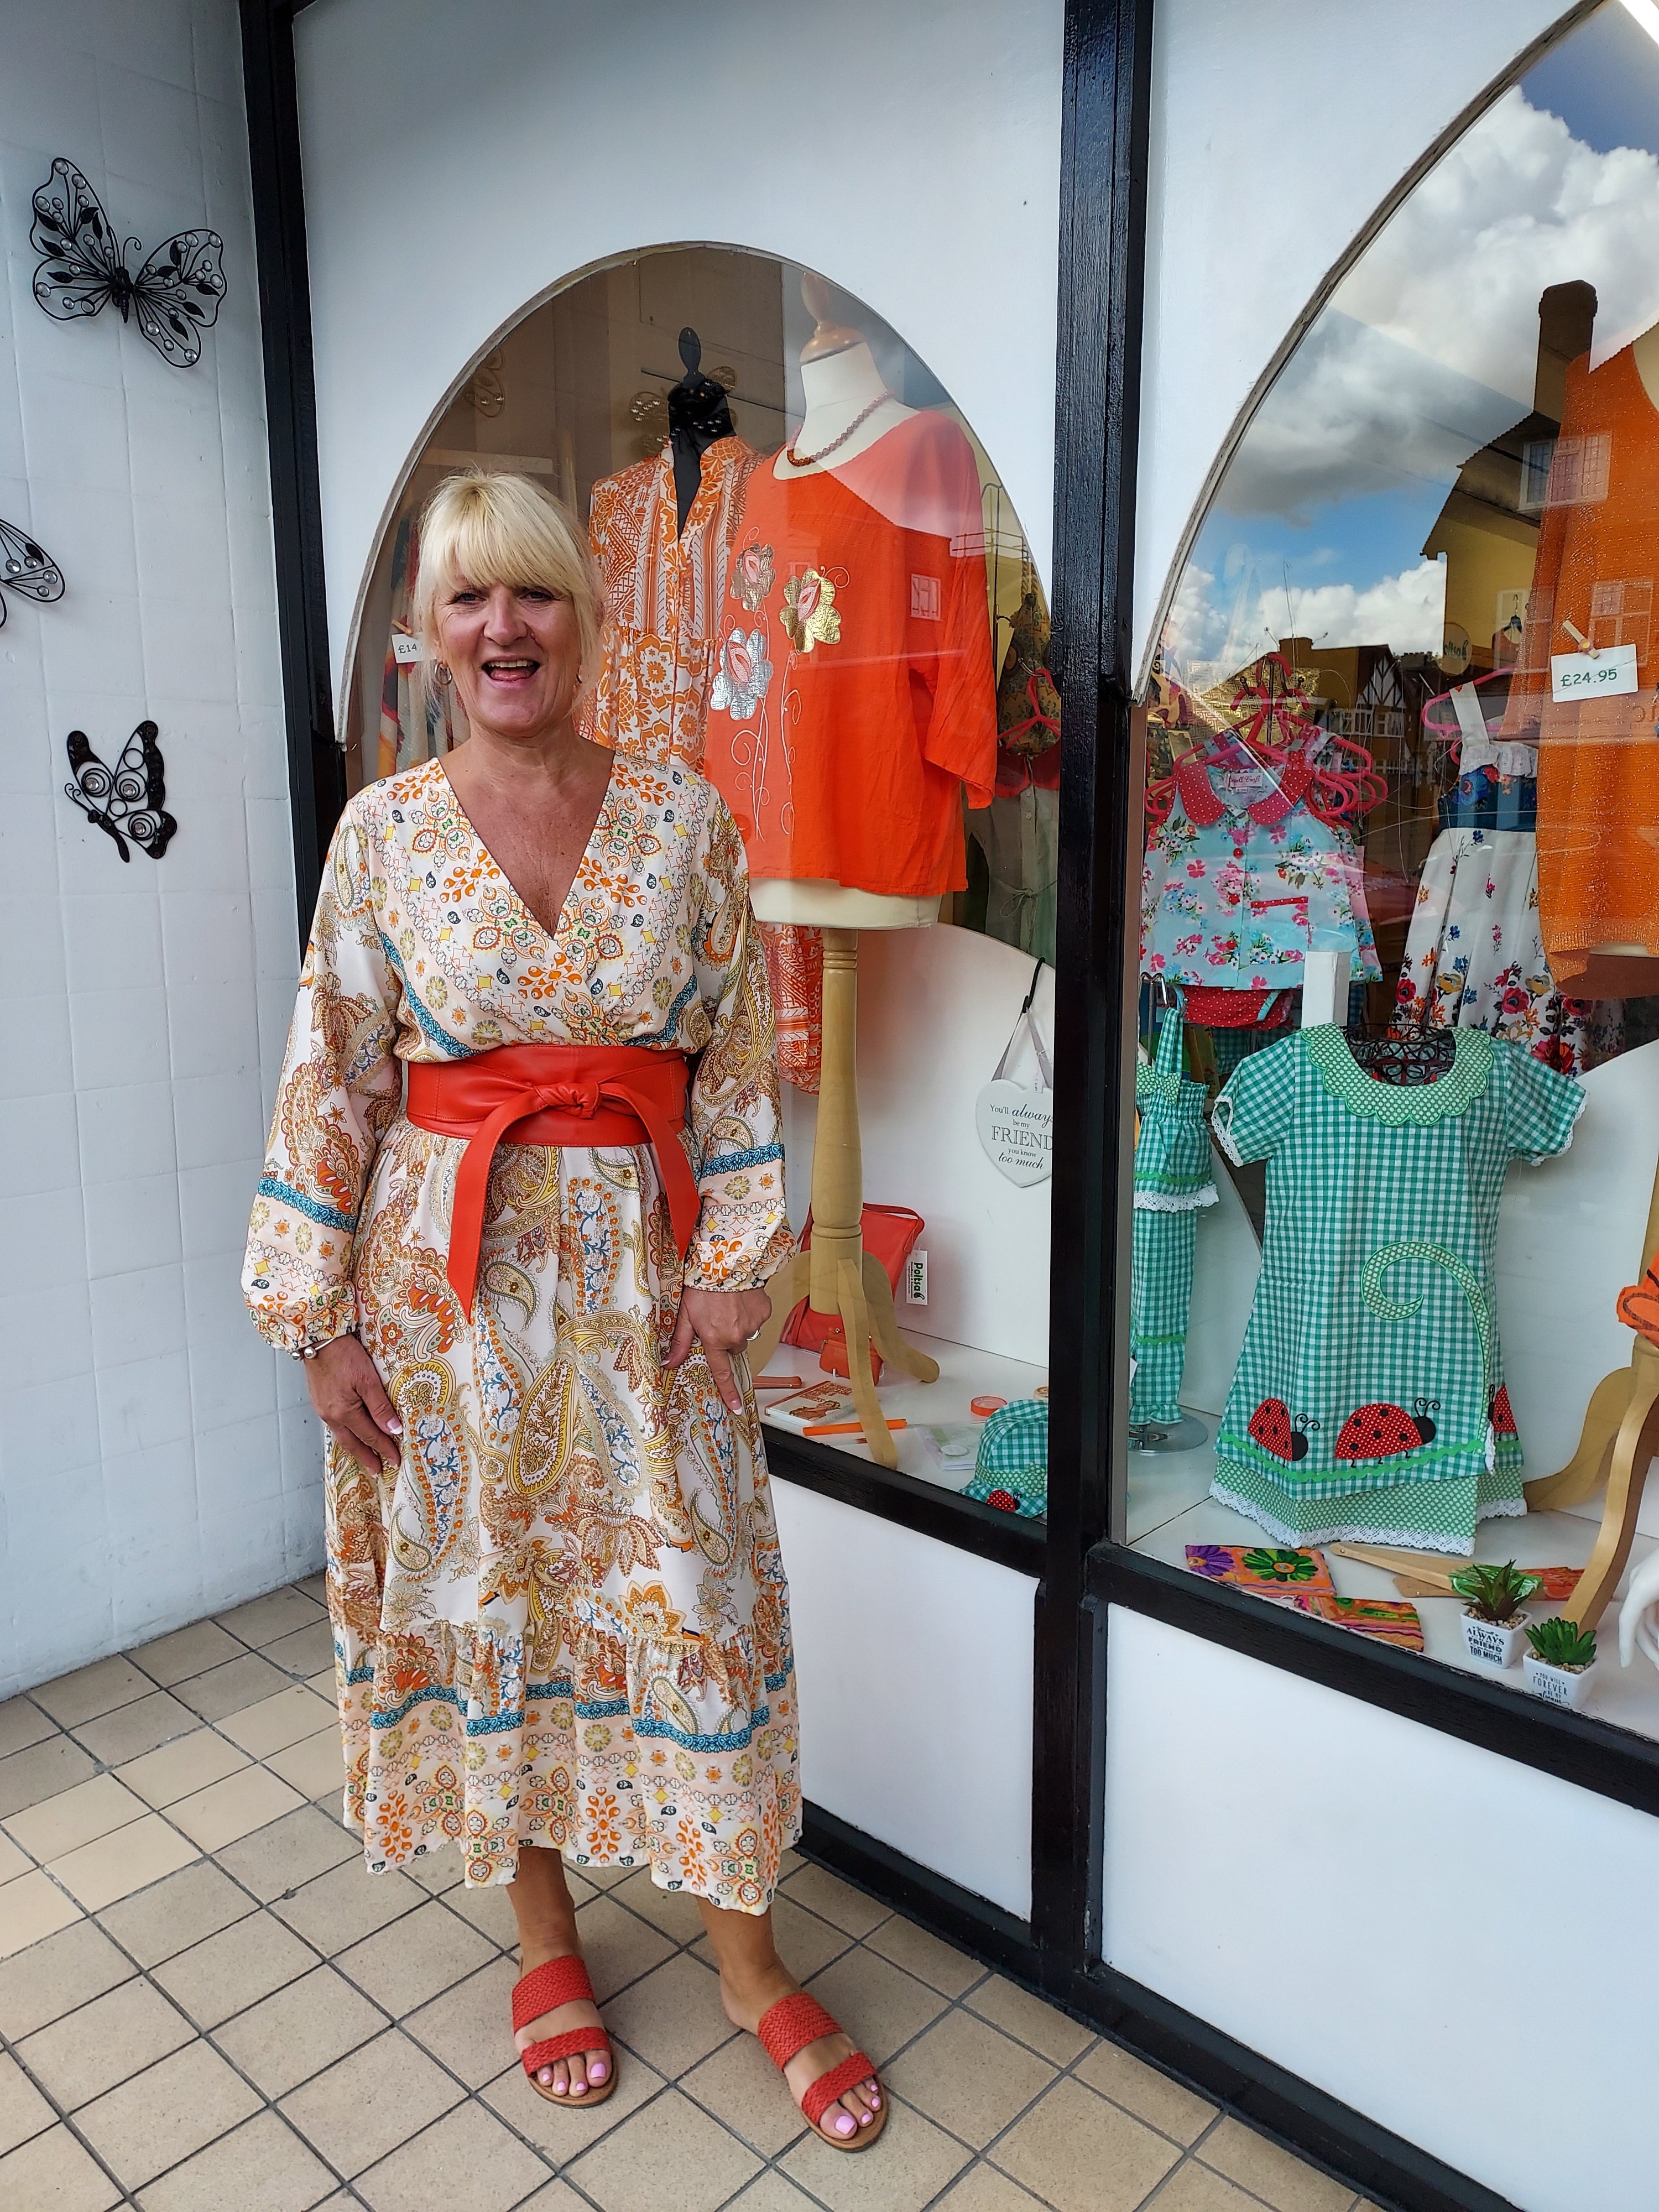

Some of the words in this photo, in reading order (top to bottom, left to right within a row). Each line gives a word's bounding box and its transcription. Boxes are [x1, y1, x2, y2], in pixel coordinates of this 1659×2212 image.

[1560, 668, 1618, 687] £24.95
[990, 1104, 1009, 1114] You'll
[990, 1125, 1053, 1150] FRIEND
[998, 1151, 1013, 1164] too
[1015, 1156, 1044, 1170] much
[1020, 1149, 1037, 1157] know
[914, 1262, 924, 1291] Poltsa
[1466, 1627, 1505, 1645] ALWAYS
[1468, 1636, 1503, 1652] FRIEND
[1469, 1645, 1482, 1656] TOO
[1483, 1651, 1503, 1665] MUCH
[1533, 1676, 1568, 1696] FOREVER
